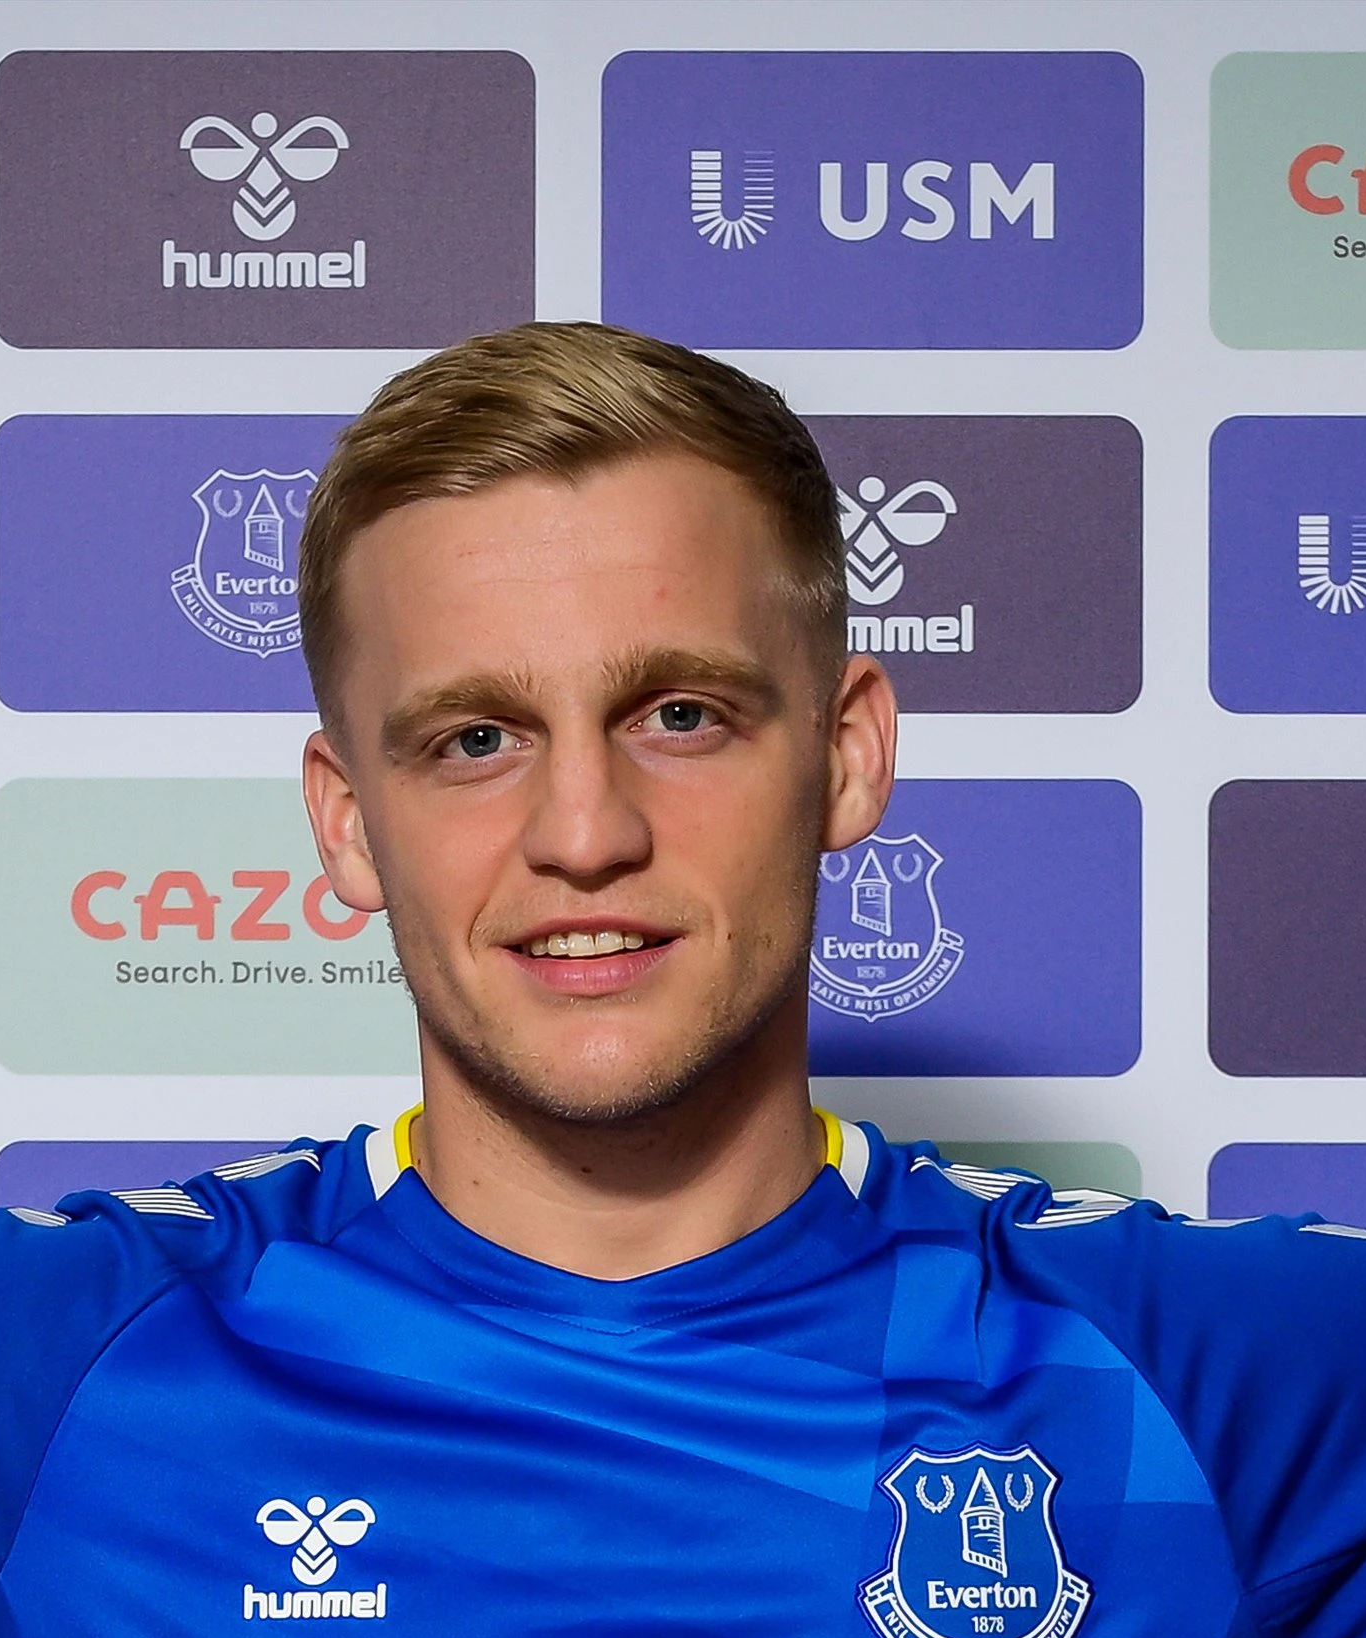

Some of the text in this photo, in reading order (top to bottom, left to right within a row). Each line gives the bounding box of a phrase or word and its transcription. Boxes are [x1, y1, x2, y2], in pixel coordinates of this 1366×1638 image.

[820, 161, 1054, 241] USM
[163, 239, 366, 288] hummel
[216, 572, 299, 595] Everto
[183, 592, 202, 619] NIL
[204, 616, 243, 643] SATIS
[248, 634, 281, 647] NISI
[847, 603, 973, 652] mmel
[70, 870, 371, 941] CAZO
[823, 937, 919, 960] Everton
[115, 960, 404, 984] Search. Drive. Smile
[811, 957, 952, 1012] SATIS NISI OPTIMUM
[243, 1582, 387, 1620] hummel
[927, 1580, 1037, 1609] Everton
[971, 1616, 1004, 1633] 1878
